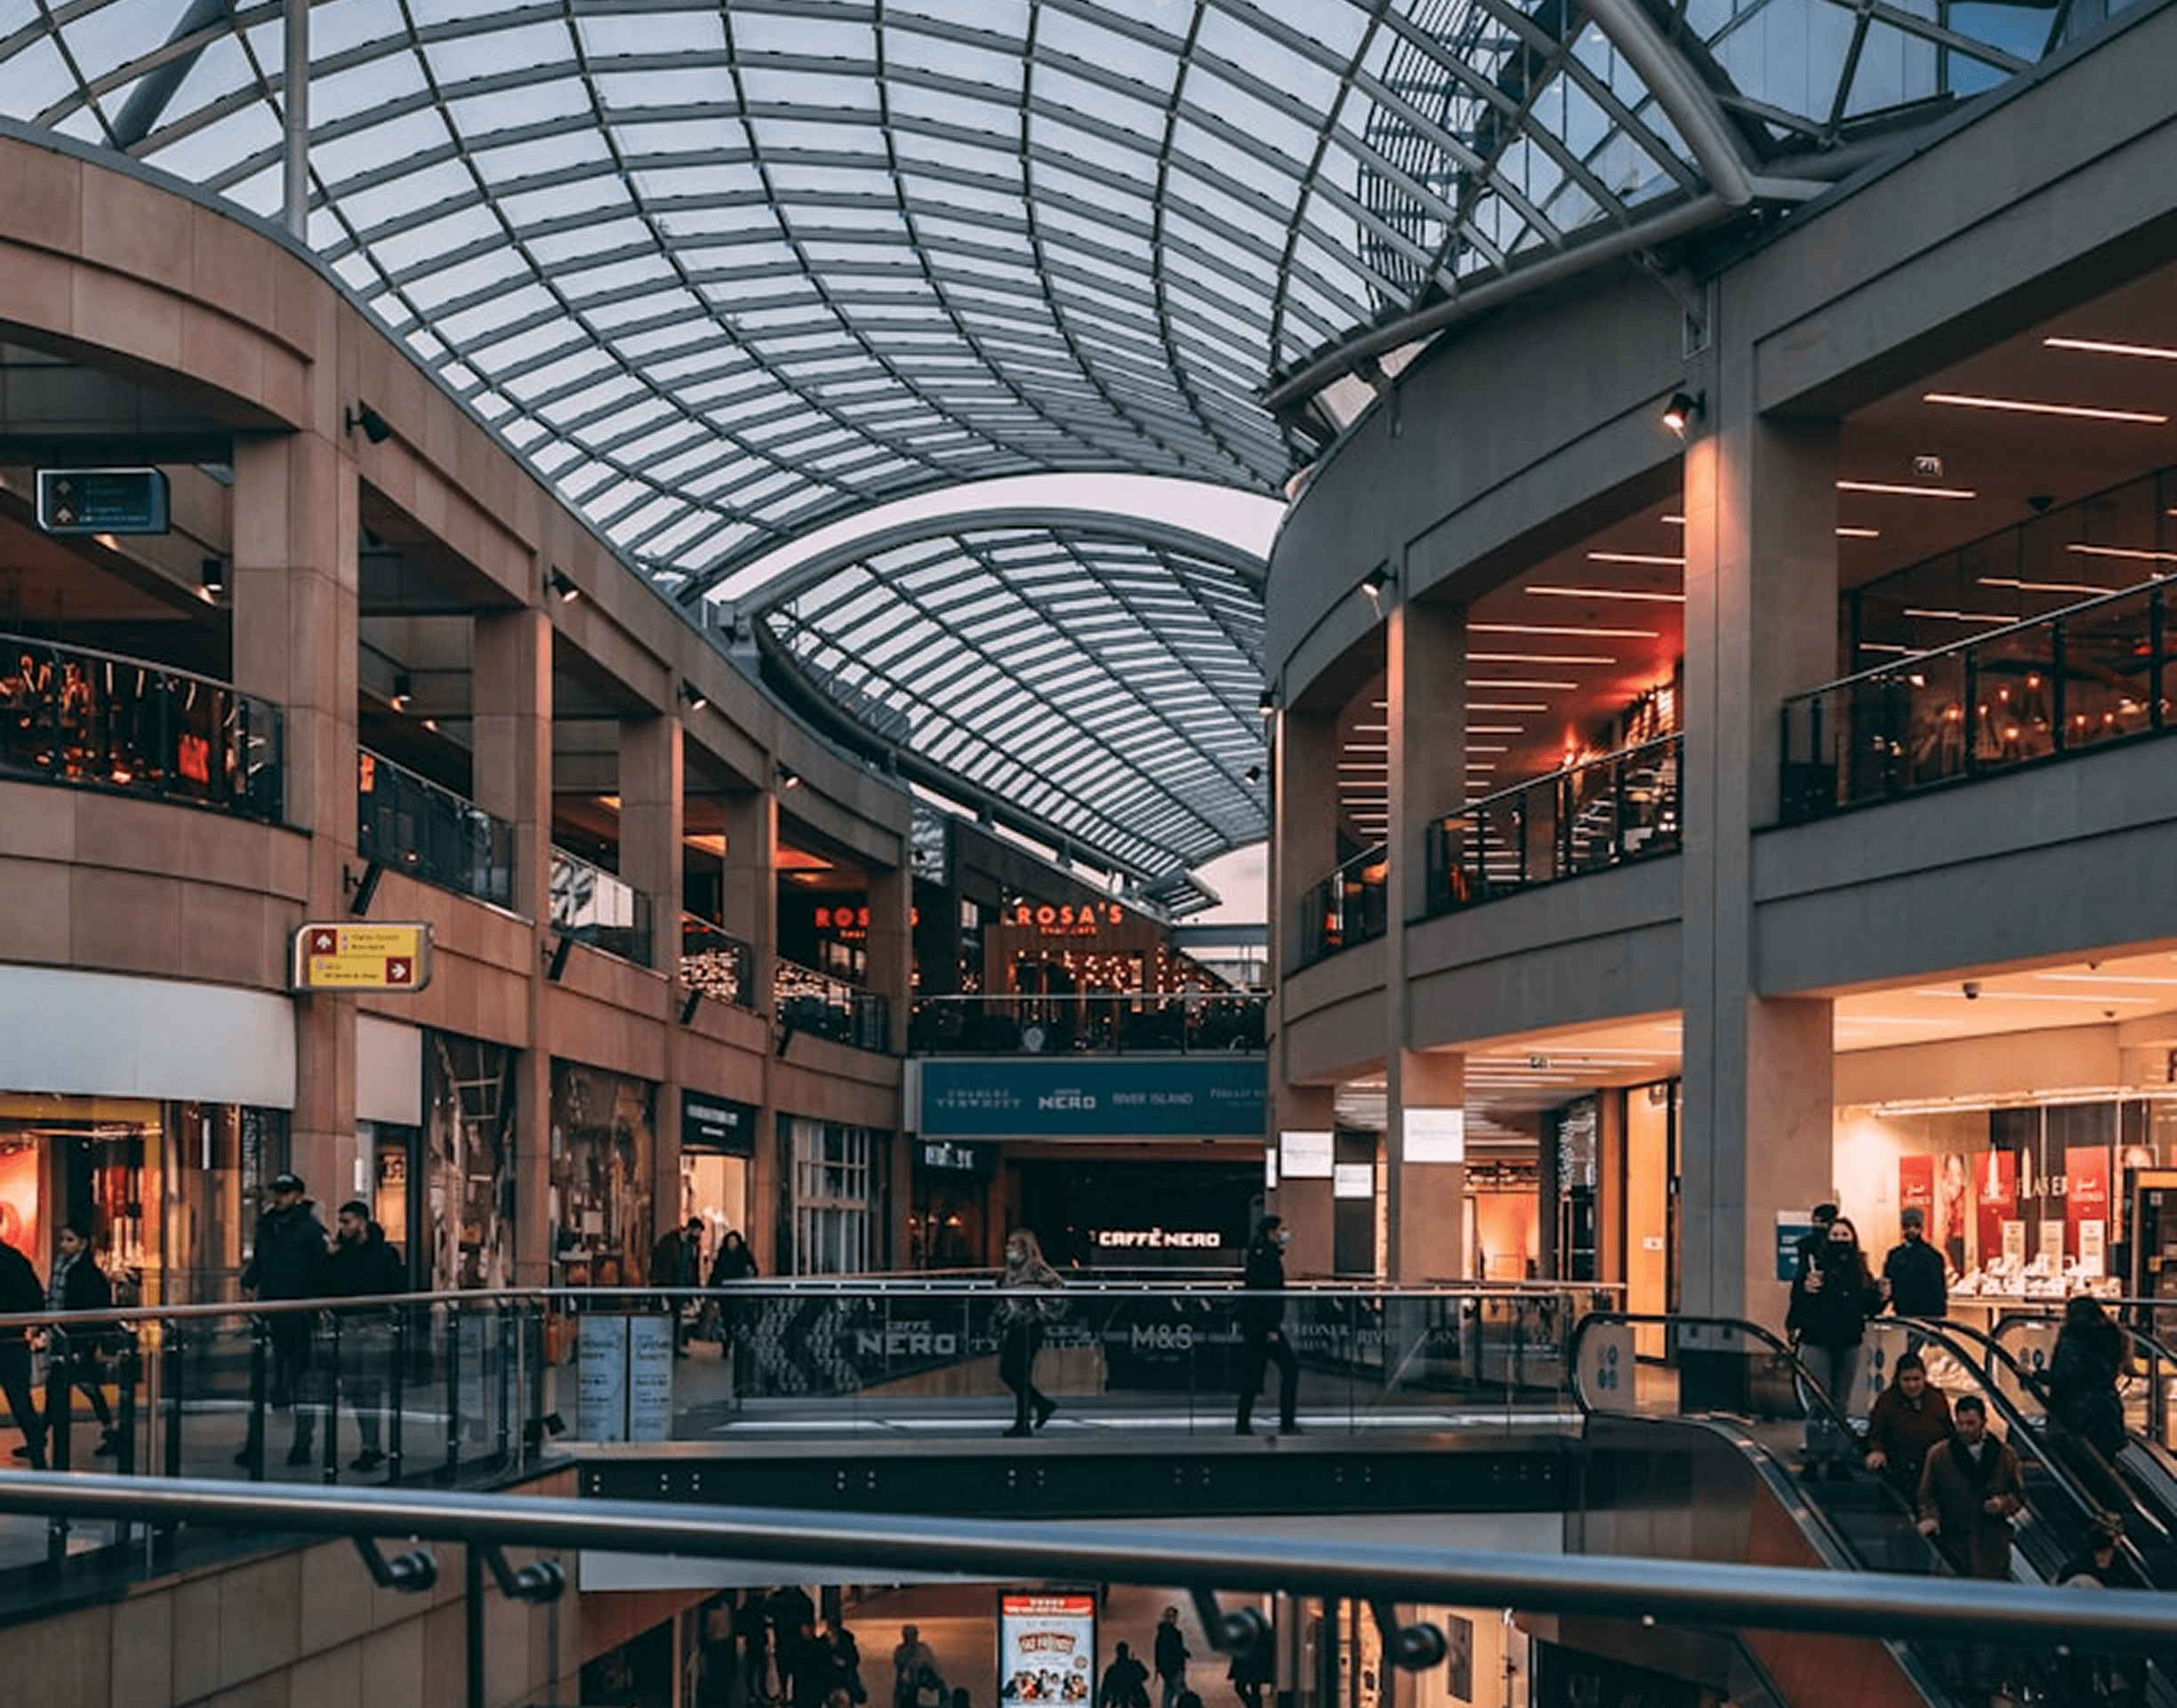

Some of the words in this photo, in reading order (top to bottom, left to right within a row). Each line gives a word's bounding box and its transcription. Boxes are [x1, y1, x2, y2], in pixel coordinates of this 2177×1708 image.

[1016, 902, 1123, 926] ROSA'S
[1038, 1096, 1097, 1110] NERO
[1112, 1092, 1147, 1105] RIVER
[1150, 1092, 1194, 1105] ISLAND
[1163, 1231, 1221, 1247] NERO
[856, 1332, 957, 1354] NERO
[1131, 1322, 1193, 1350] M&S
